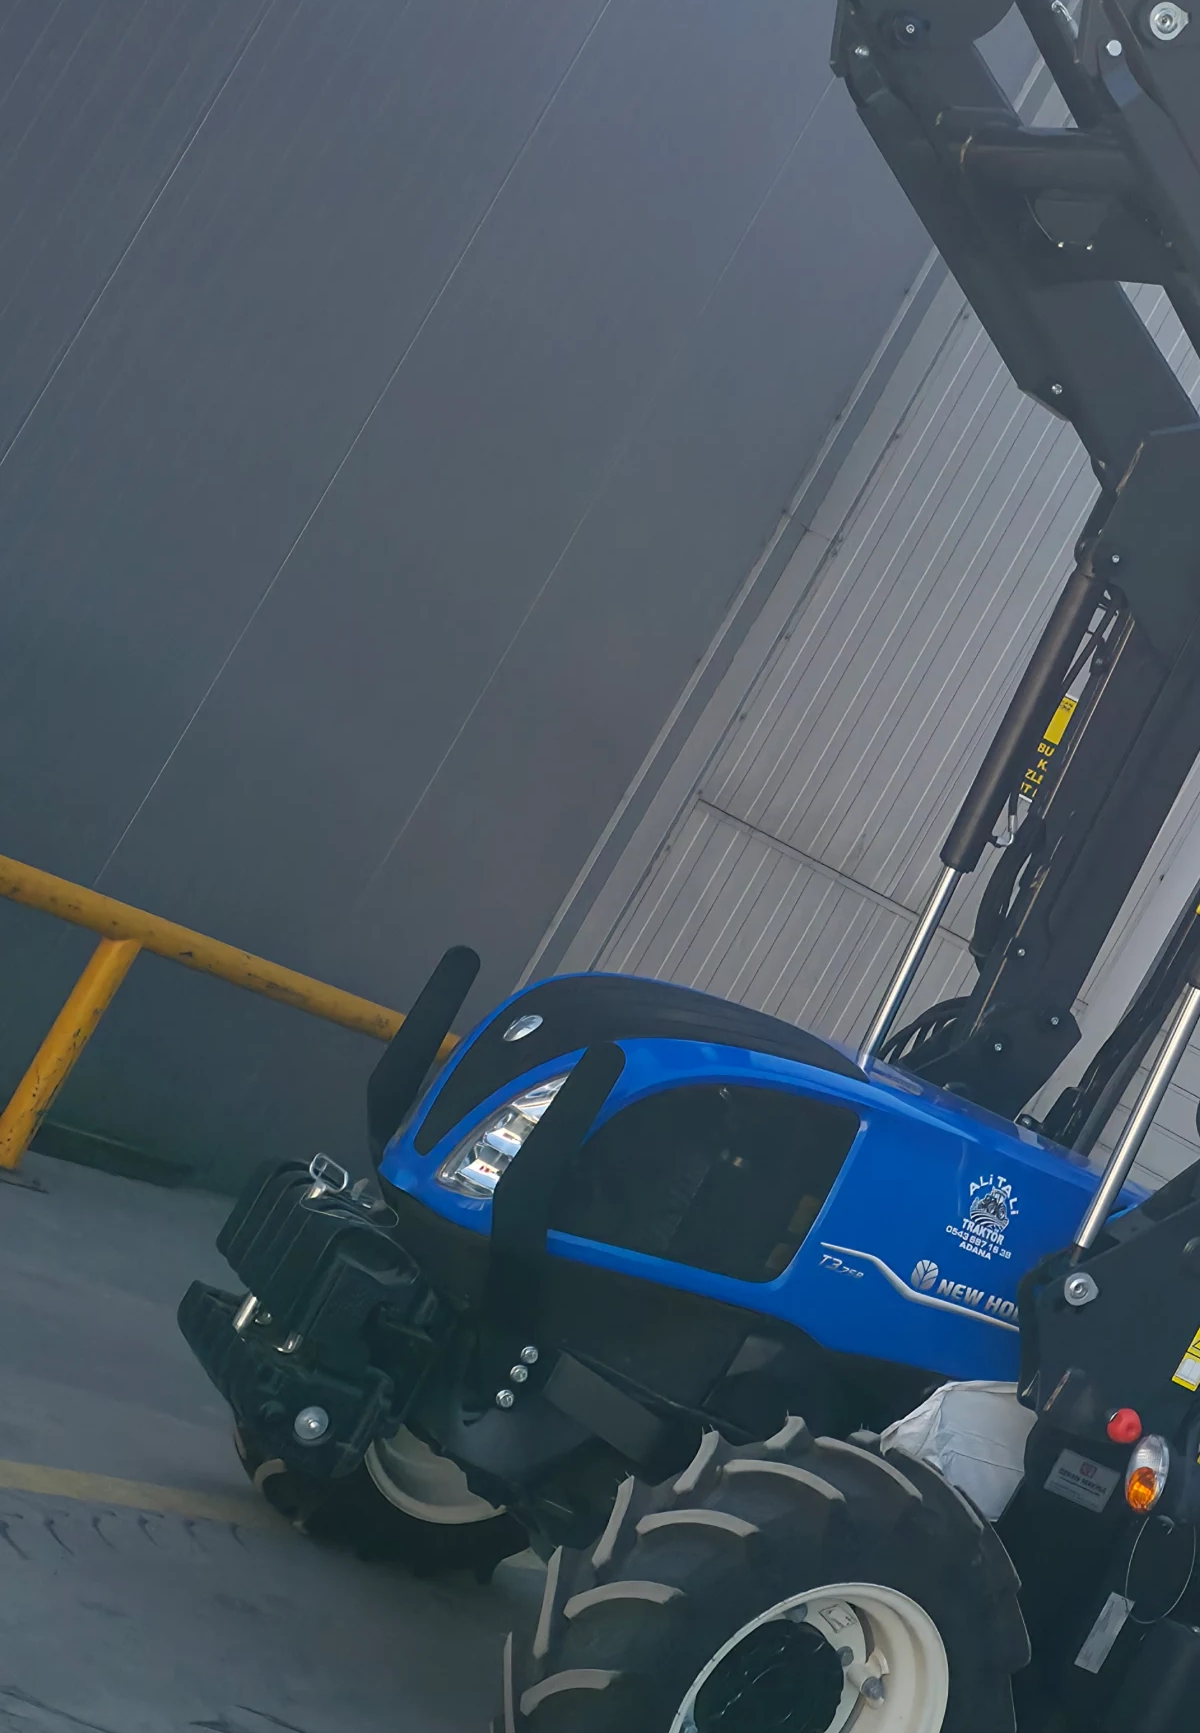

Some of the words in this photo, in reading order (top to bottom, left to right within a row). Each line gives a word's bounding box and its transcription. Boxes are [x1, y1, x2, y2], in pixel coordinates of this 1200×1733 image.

[946, 1225, 969, 1241] 0543
[959, 1241, 991, 1260] ADANA
[937, 1279, 985, 1307] NEW
